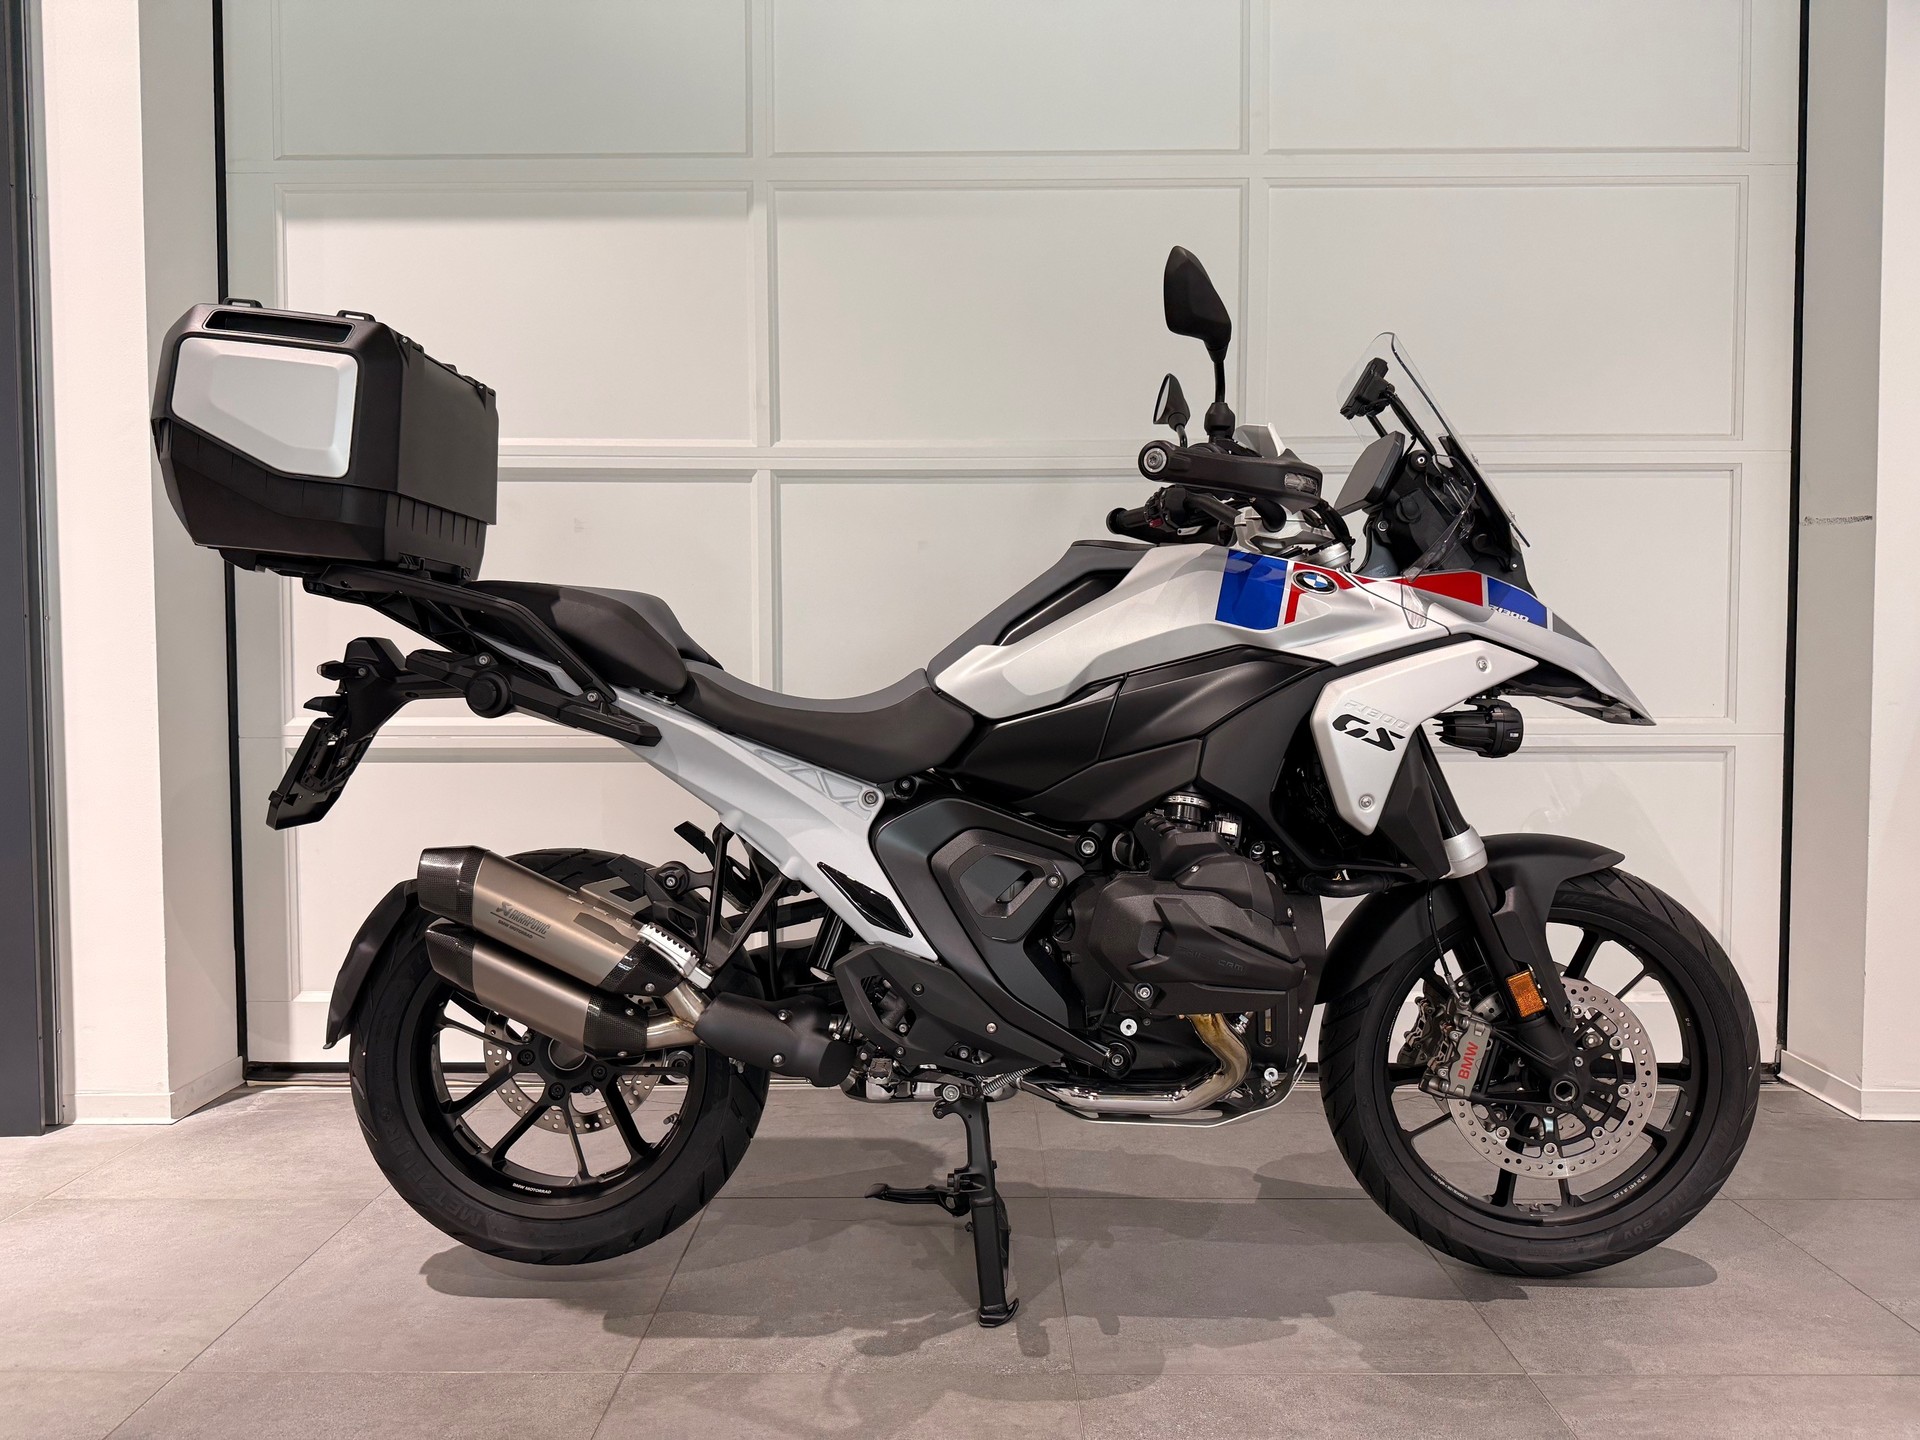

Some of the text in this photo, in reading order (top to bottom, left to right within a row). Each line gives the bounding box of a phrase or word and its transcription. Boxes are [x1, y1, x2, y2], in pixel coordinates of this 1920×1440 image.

[1331, 713, 1406, 752] GS
[1458, 1041, 1478, 1079] BMW
[512, 1182, 552, 1195] BMW MOTORRAD
